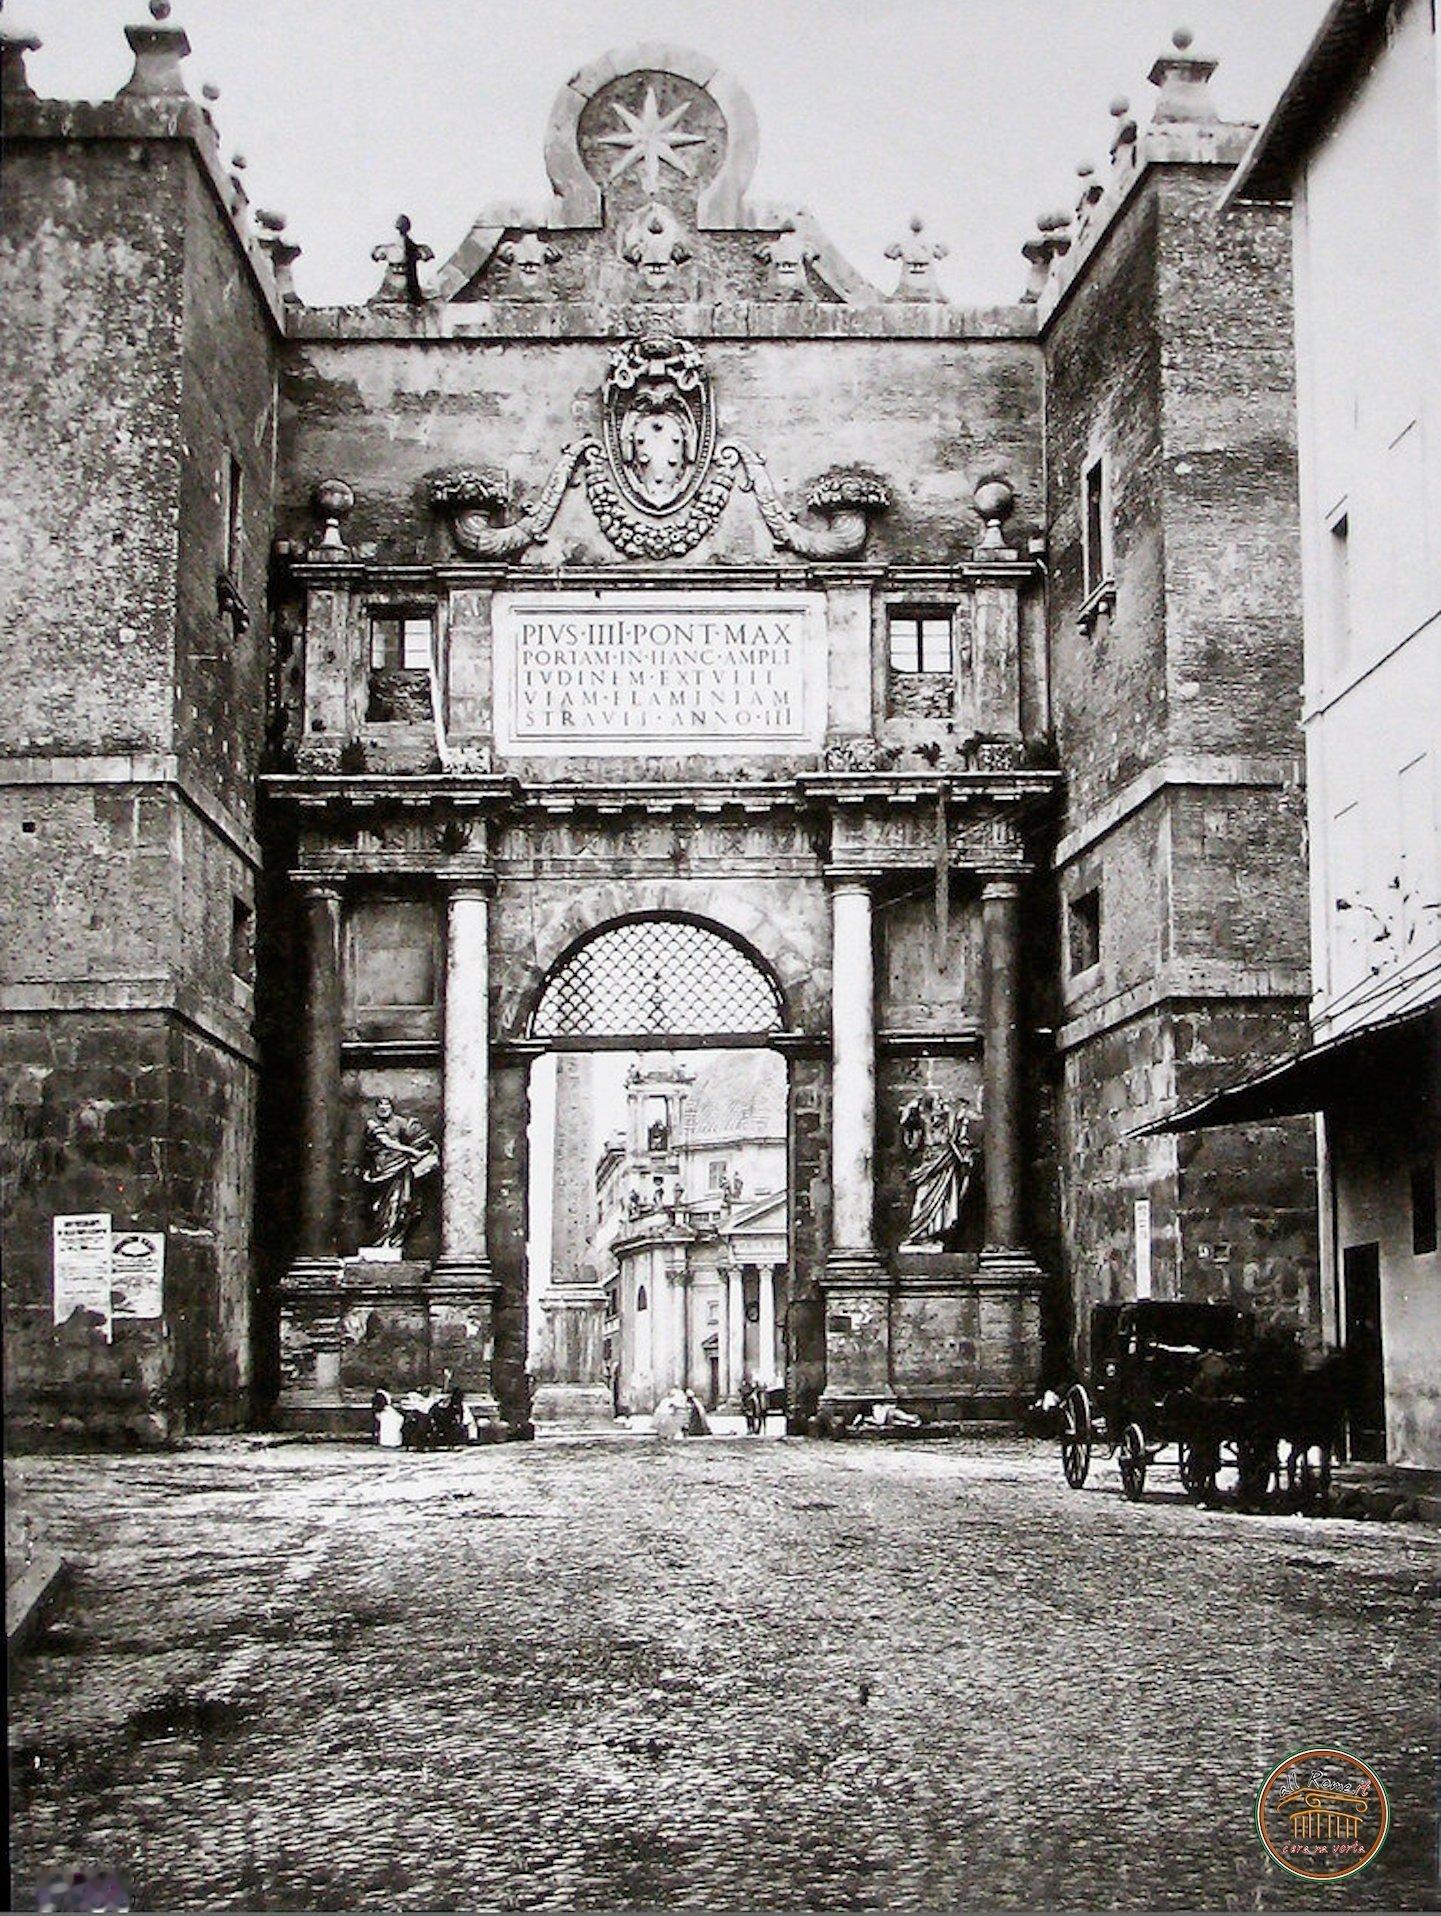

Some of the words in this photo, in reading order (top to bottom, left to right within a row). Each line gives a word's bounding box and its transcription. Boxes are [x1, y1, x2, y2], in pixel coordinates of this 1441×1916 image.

[523, 624, 578, 645] PIVS
[634, 624, 716, 645] PONT
[725, 624, 791, 645] MAX
[620, 650, 642, 665] IN
[524, 690, 597, 706] VIAM
[671, 710, 751, 726] ANNO
[766, 708, 791, 726] III
